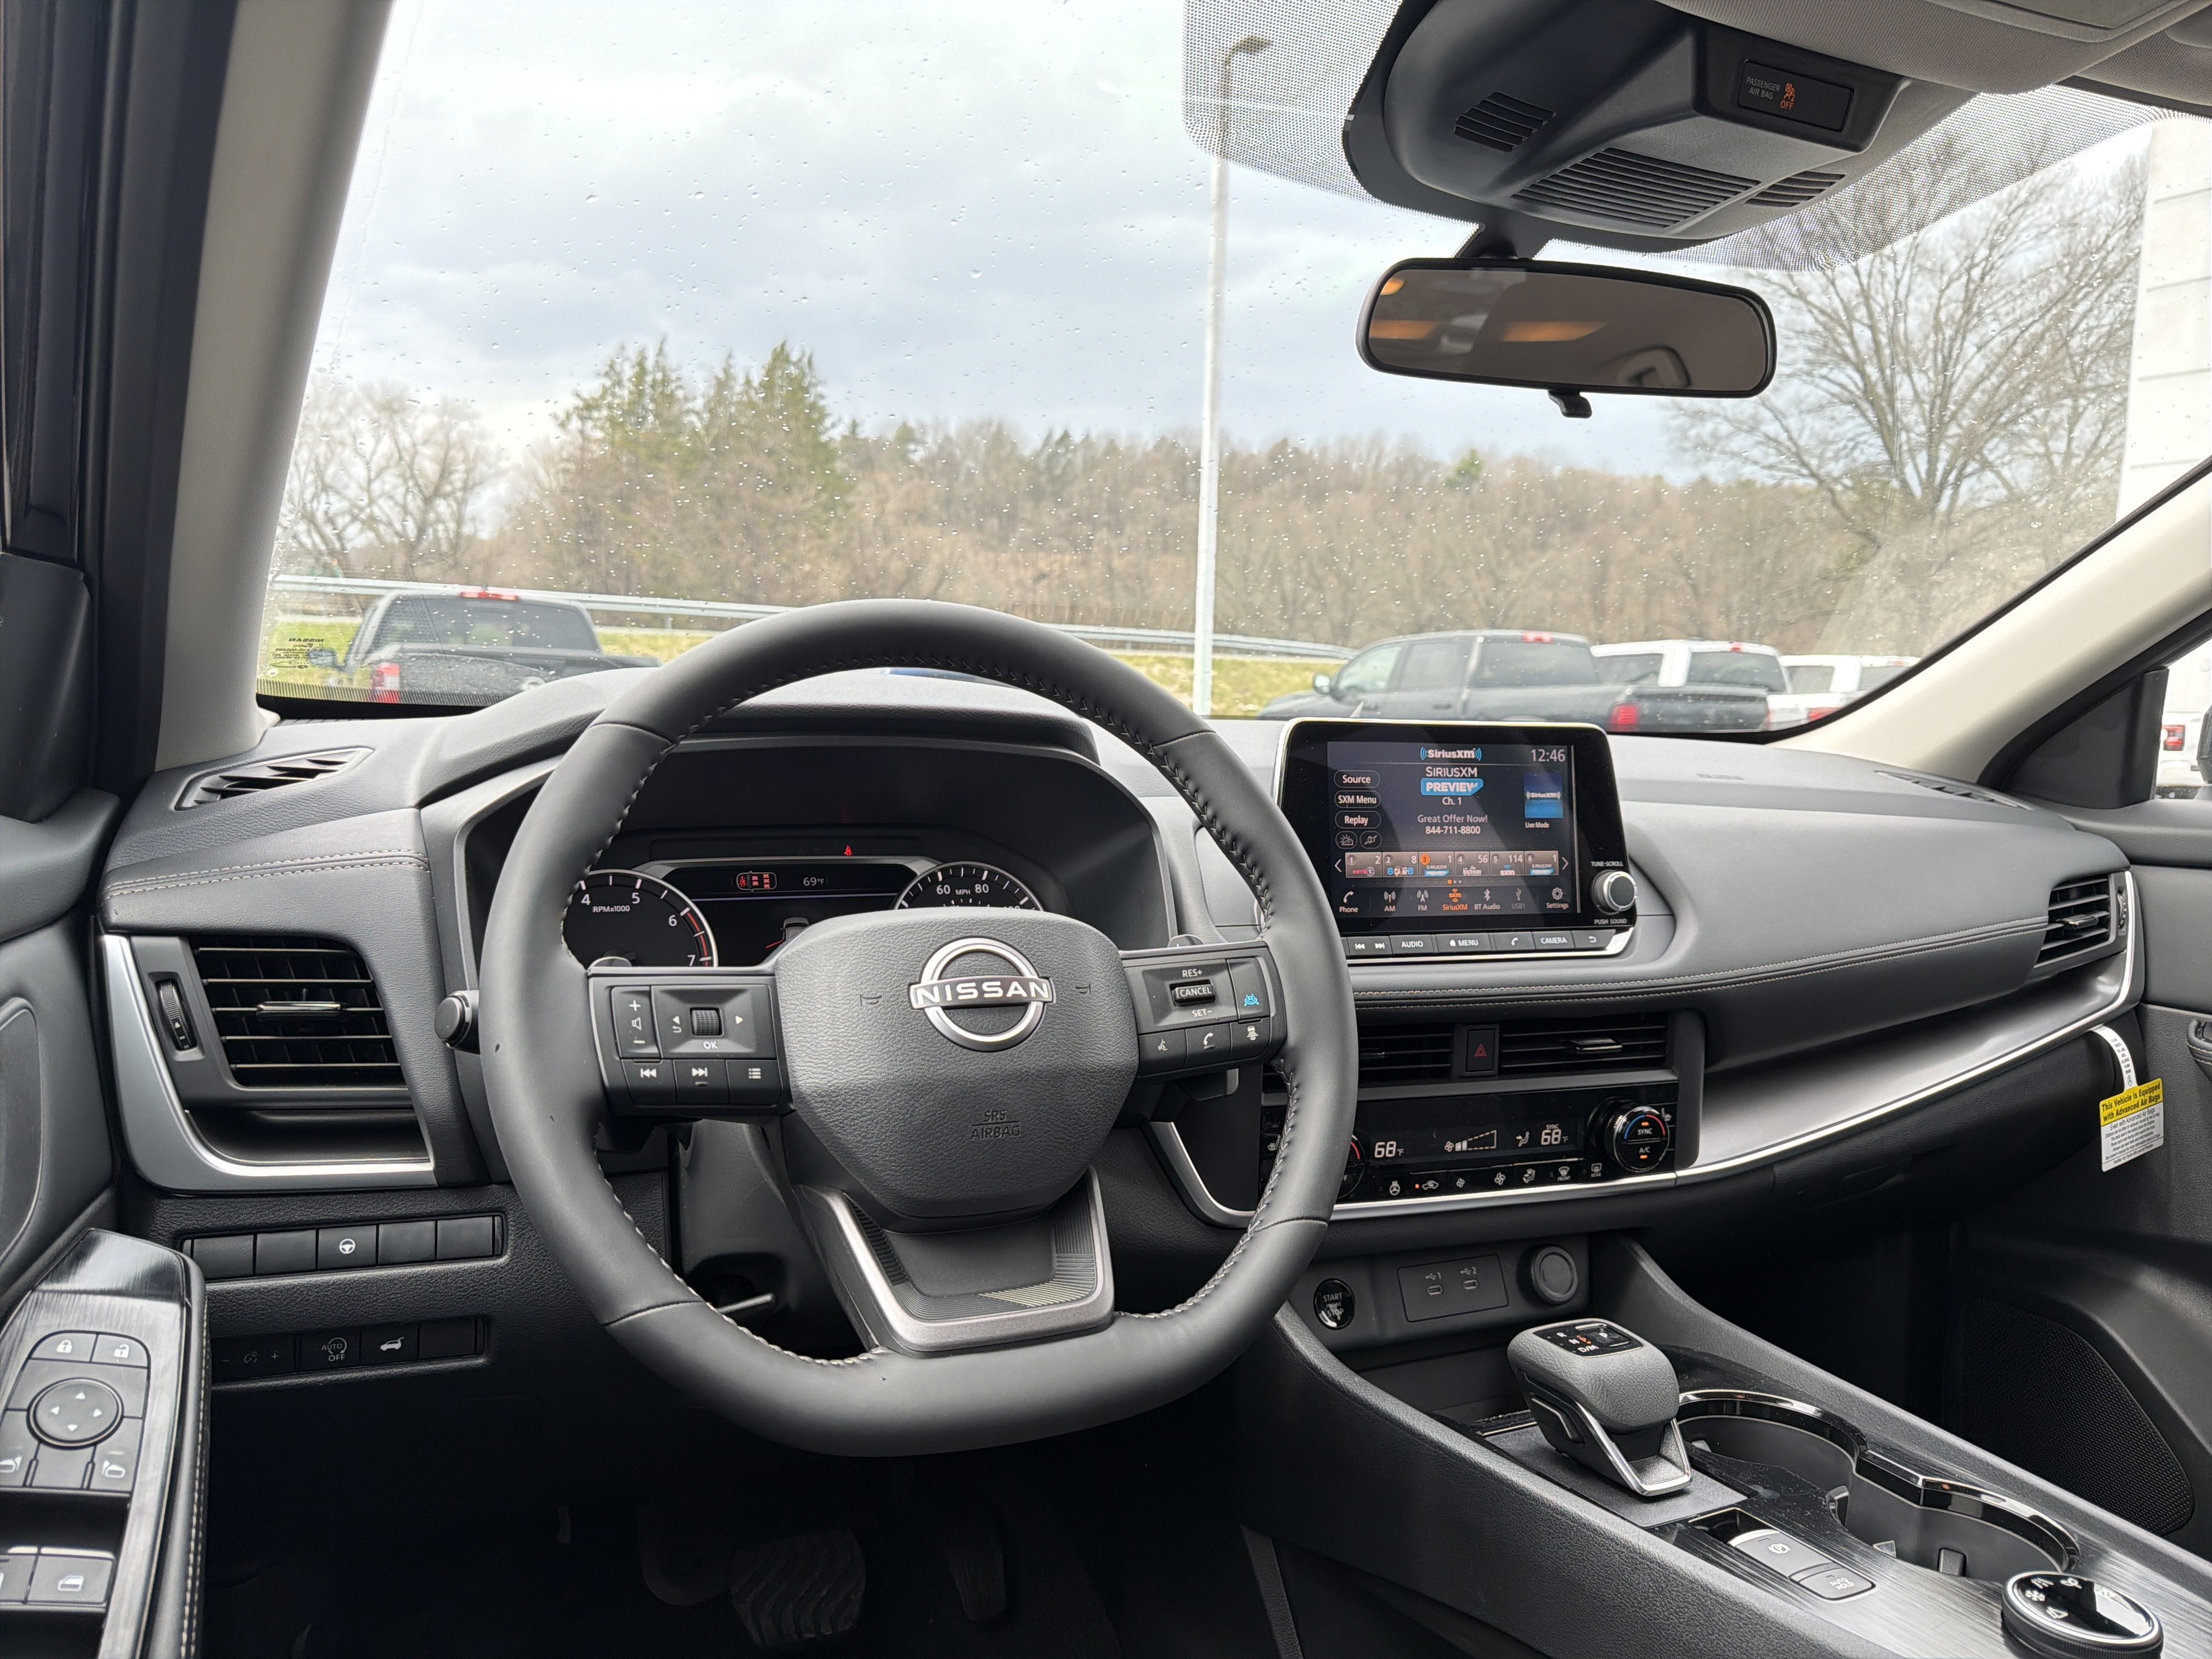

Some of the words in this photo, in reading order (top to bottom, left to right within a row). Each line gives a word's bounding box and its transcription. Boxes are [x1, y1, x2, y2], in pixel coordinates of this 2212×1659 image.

[1746, 77, 1780, 92] PASSENGER
[1748, 87, 1760, 97] AIR
[1760, 89, 1773, 100] BAG
[1780, 100, 1795, 110] OFF
[1531, 749, 1566, 762] 12:46
[1425, 766, 1477, 777] SIRIUSXM
[1342, 775, 1371, 784] Source
[1426, 782, 1478, 792] PREVIEW
[1338, 795, 1355, 804] SXM
[1356, 795, 1376, 804] Menu
[1442, 797, 1455, 805] Ch.
[1344, 815, 1368, 826] Replay
[1417, 814, 1441, 823] Great
[1442, 814, 1465, 823] Offer
[1467, 814, 1488, 823] Now!
[1425, 826, 1481, 834] 844-711-8800
[1375, 856, 1381, 865] 2
[1411, 855, 1417, 864] 8
[1448, 855, 1452, 864] 1
[1478, 854, 1488, 864] 56
[1509, 854, 1523, 863] 114
[936, 884, 951, 895] 60
[974, 884, 989, 894] 80
[581, 894, 591, 905] 4
[631, 892, 640, 904] 5
[668, 915, 677, 927] 6
[1401, 940, 1424, 949] AUDIO
[1458, 939, 1479, 947] MENU
[1540, 936, 1567, 945] CAMERA
[687, 955, 696, 966] 7
[916, 981, 1050, 1006] NISSAN
[1180, 986, 1212, 997] CANCEL
[703, 1041, 719, 1049] OK
[2102, 1102, 2113, 1112] This
[2114, 1094, 2132, 1107] Vehicle
[2138, 1082, 2160, 1097] Equipped
[2103, 1112, 2114, 1122] with
[2115, 1101, 2140, 1116] Advanced
[2148, 1094, 2160, 1103] Bags
[984, 1109, 1007, 1122] SRS
[969, 1125, 1021, 1141] AIRBAG
[1471, 1266, 1477, 1274] 2
[1323, 1292, 1342, 1302] START
[1327, 1308, 1344, 1317] STOP
[328, 1353, 346, 1362] OFF
[1830, 1577, 1849, 1587] AUTO
[1835, 1581, 1855, 1590] HOLD
